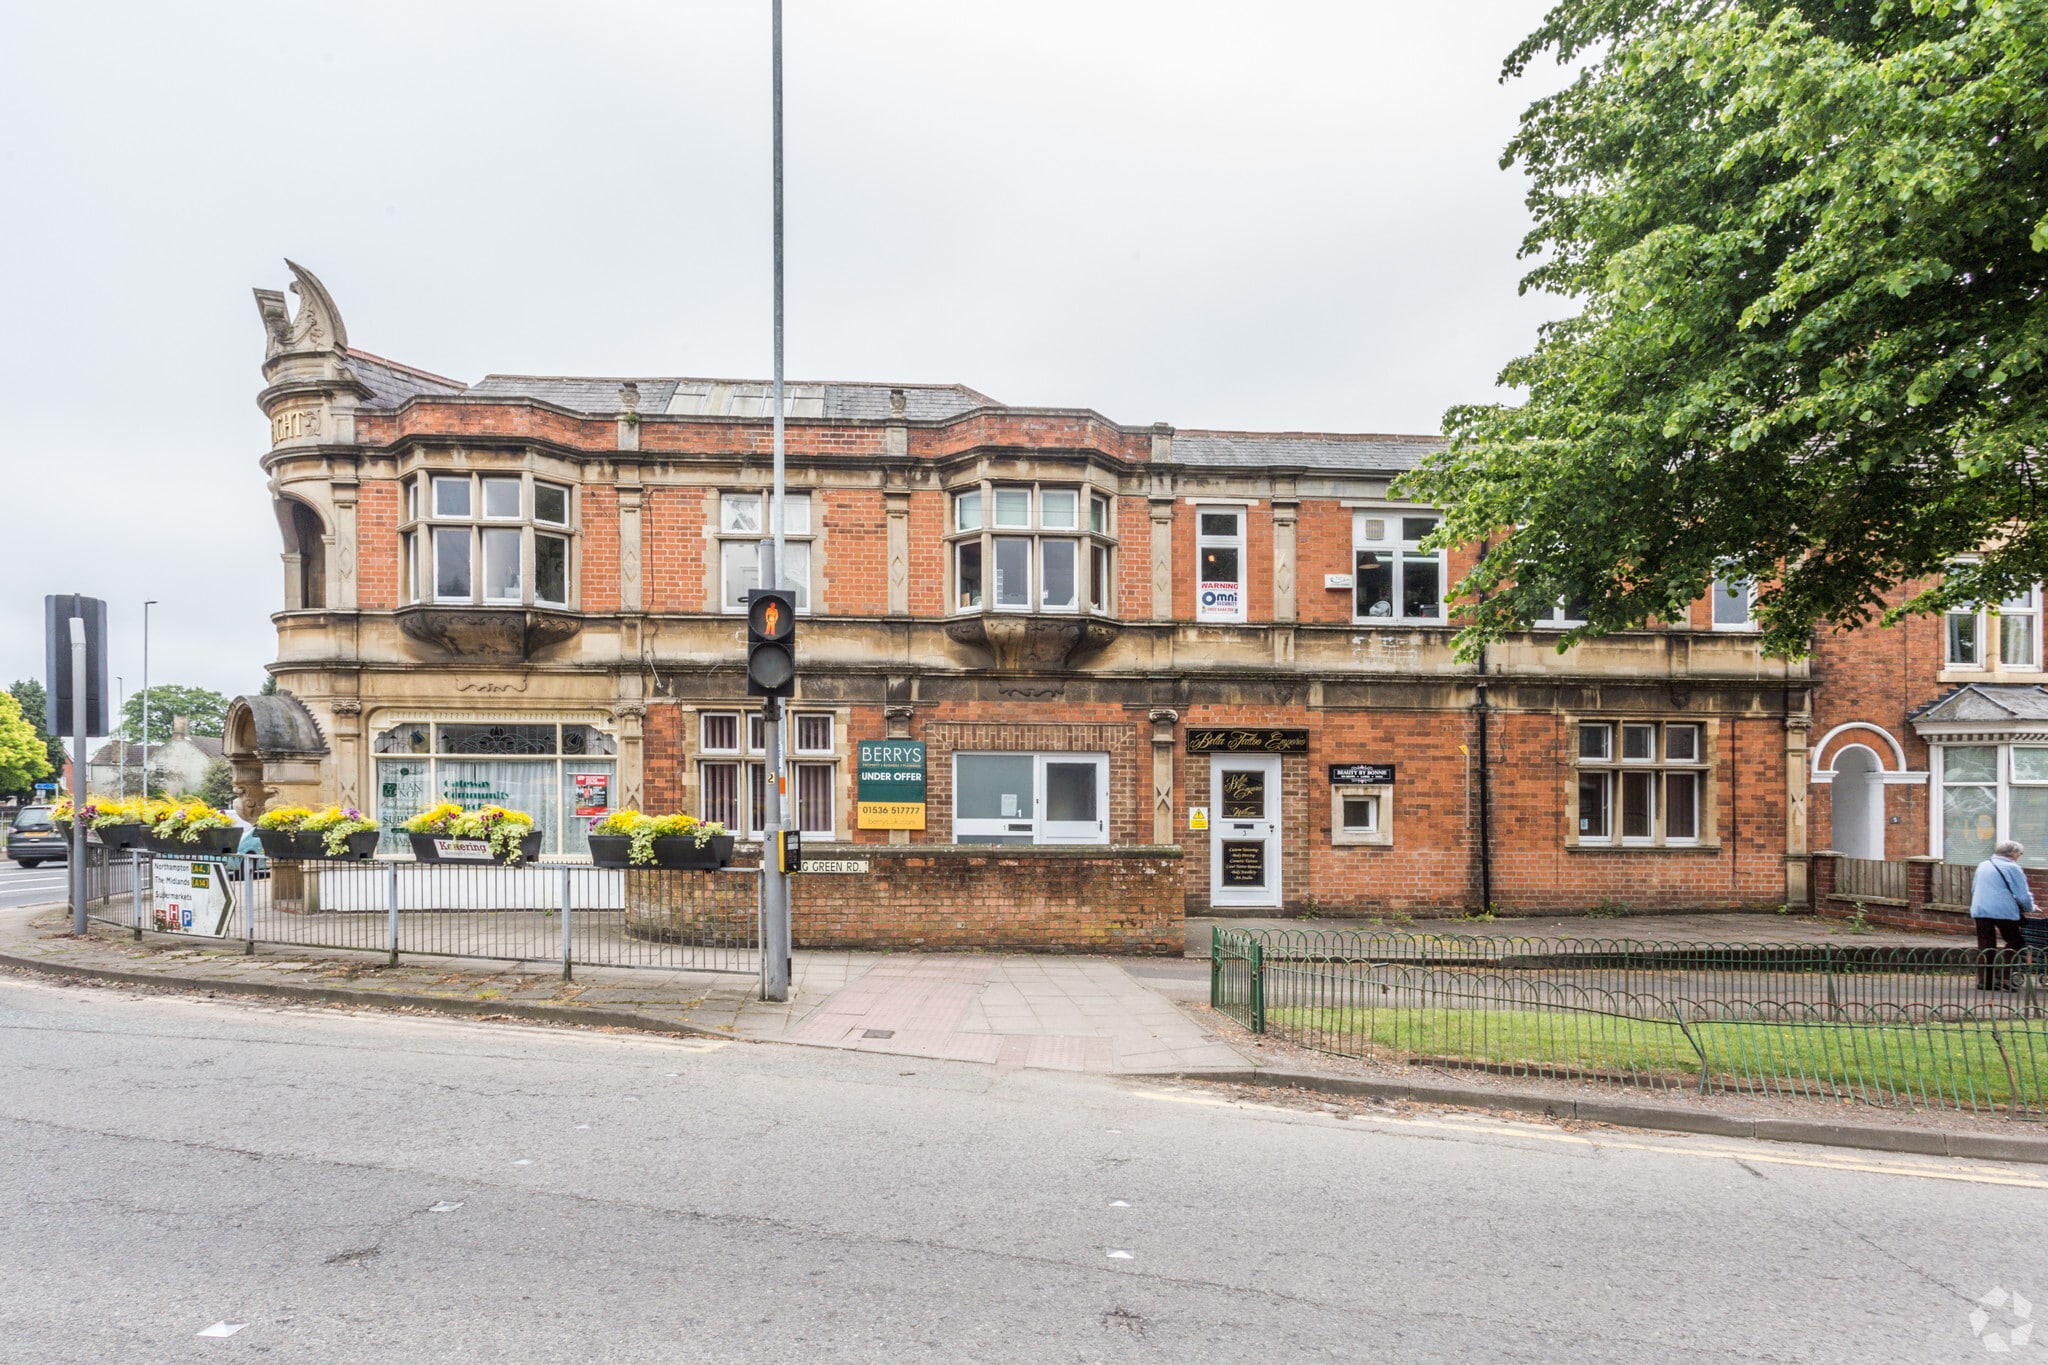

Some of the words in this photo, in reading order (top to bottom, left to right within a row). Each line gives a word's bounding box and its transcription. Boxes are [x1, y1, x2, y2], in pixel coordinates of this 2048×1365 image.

[1202, 591, 1237, 605] Omni
[1190, 731, 1225, 748] Bella
[1227, 729, 1262, 750] Tattoo
[862, 746, 922, 763] BERRYS
[768, 774, 773, 784] 2
[861, 772, 891, 781] UNDER
[893, 772, 922, 781] OFFER
[444, 779, 491, 789] Gateway
[400, 790, 422, 798] NOT
[443, 791, 510, 800] Community
[862, 806, 888, 814] 01536
[891, 807, 920, 815] 517777
[1017, 809, 1022, 817] 1
[439, 841, 487, 854] Ketering
[155, 863, 190, 872] Northampton
[812, 861, 842, 872] GREEN
[846, 862, 862, 872] RD.
[166, 877, 190, 886] Midlands
[170, 905, 178, 920] H
[184, 912, 190, 925] P
